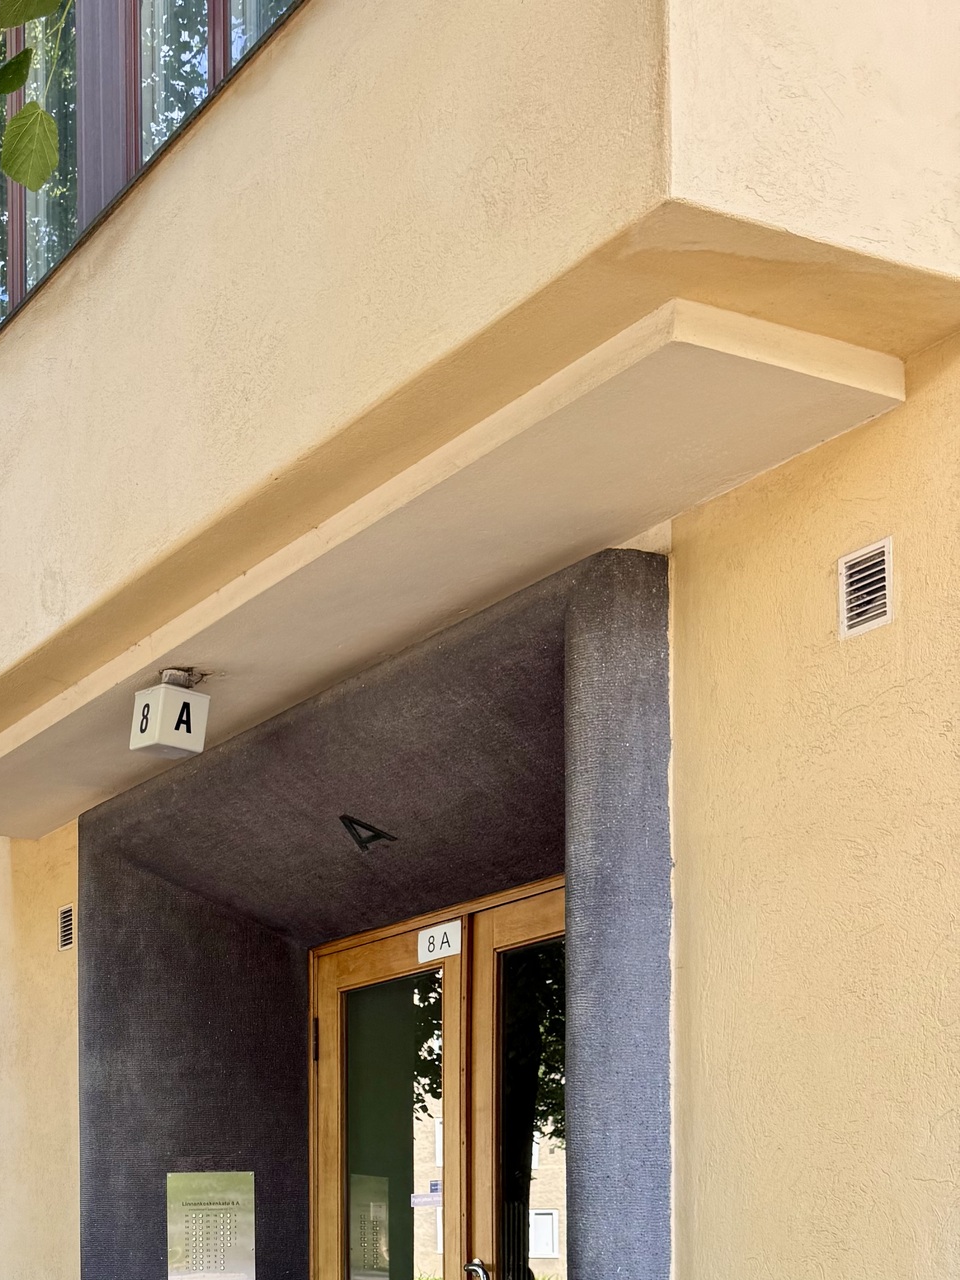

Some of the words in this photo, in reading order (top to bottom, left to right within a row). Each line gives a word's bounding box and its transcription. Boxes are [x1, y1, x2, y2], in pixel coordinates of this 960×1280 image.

[139, 703, 150, 734] 8
[174, 701, 192, 734] A
[340, 814, 398, 852] A
[427, 935, 435, 953] 8
[440, 931, 451, 951] A
